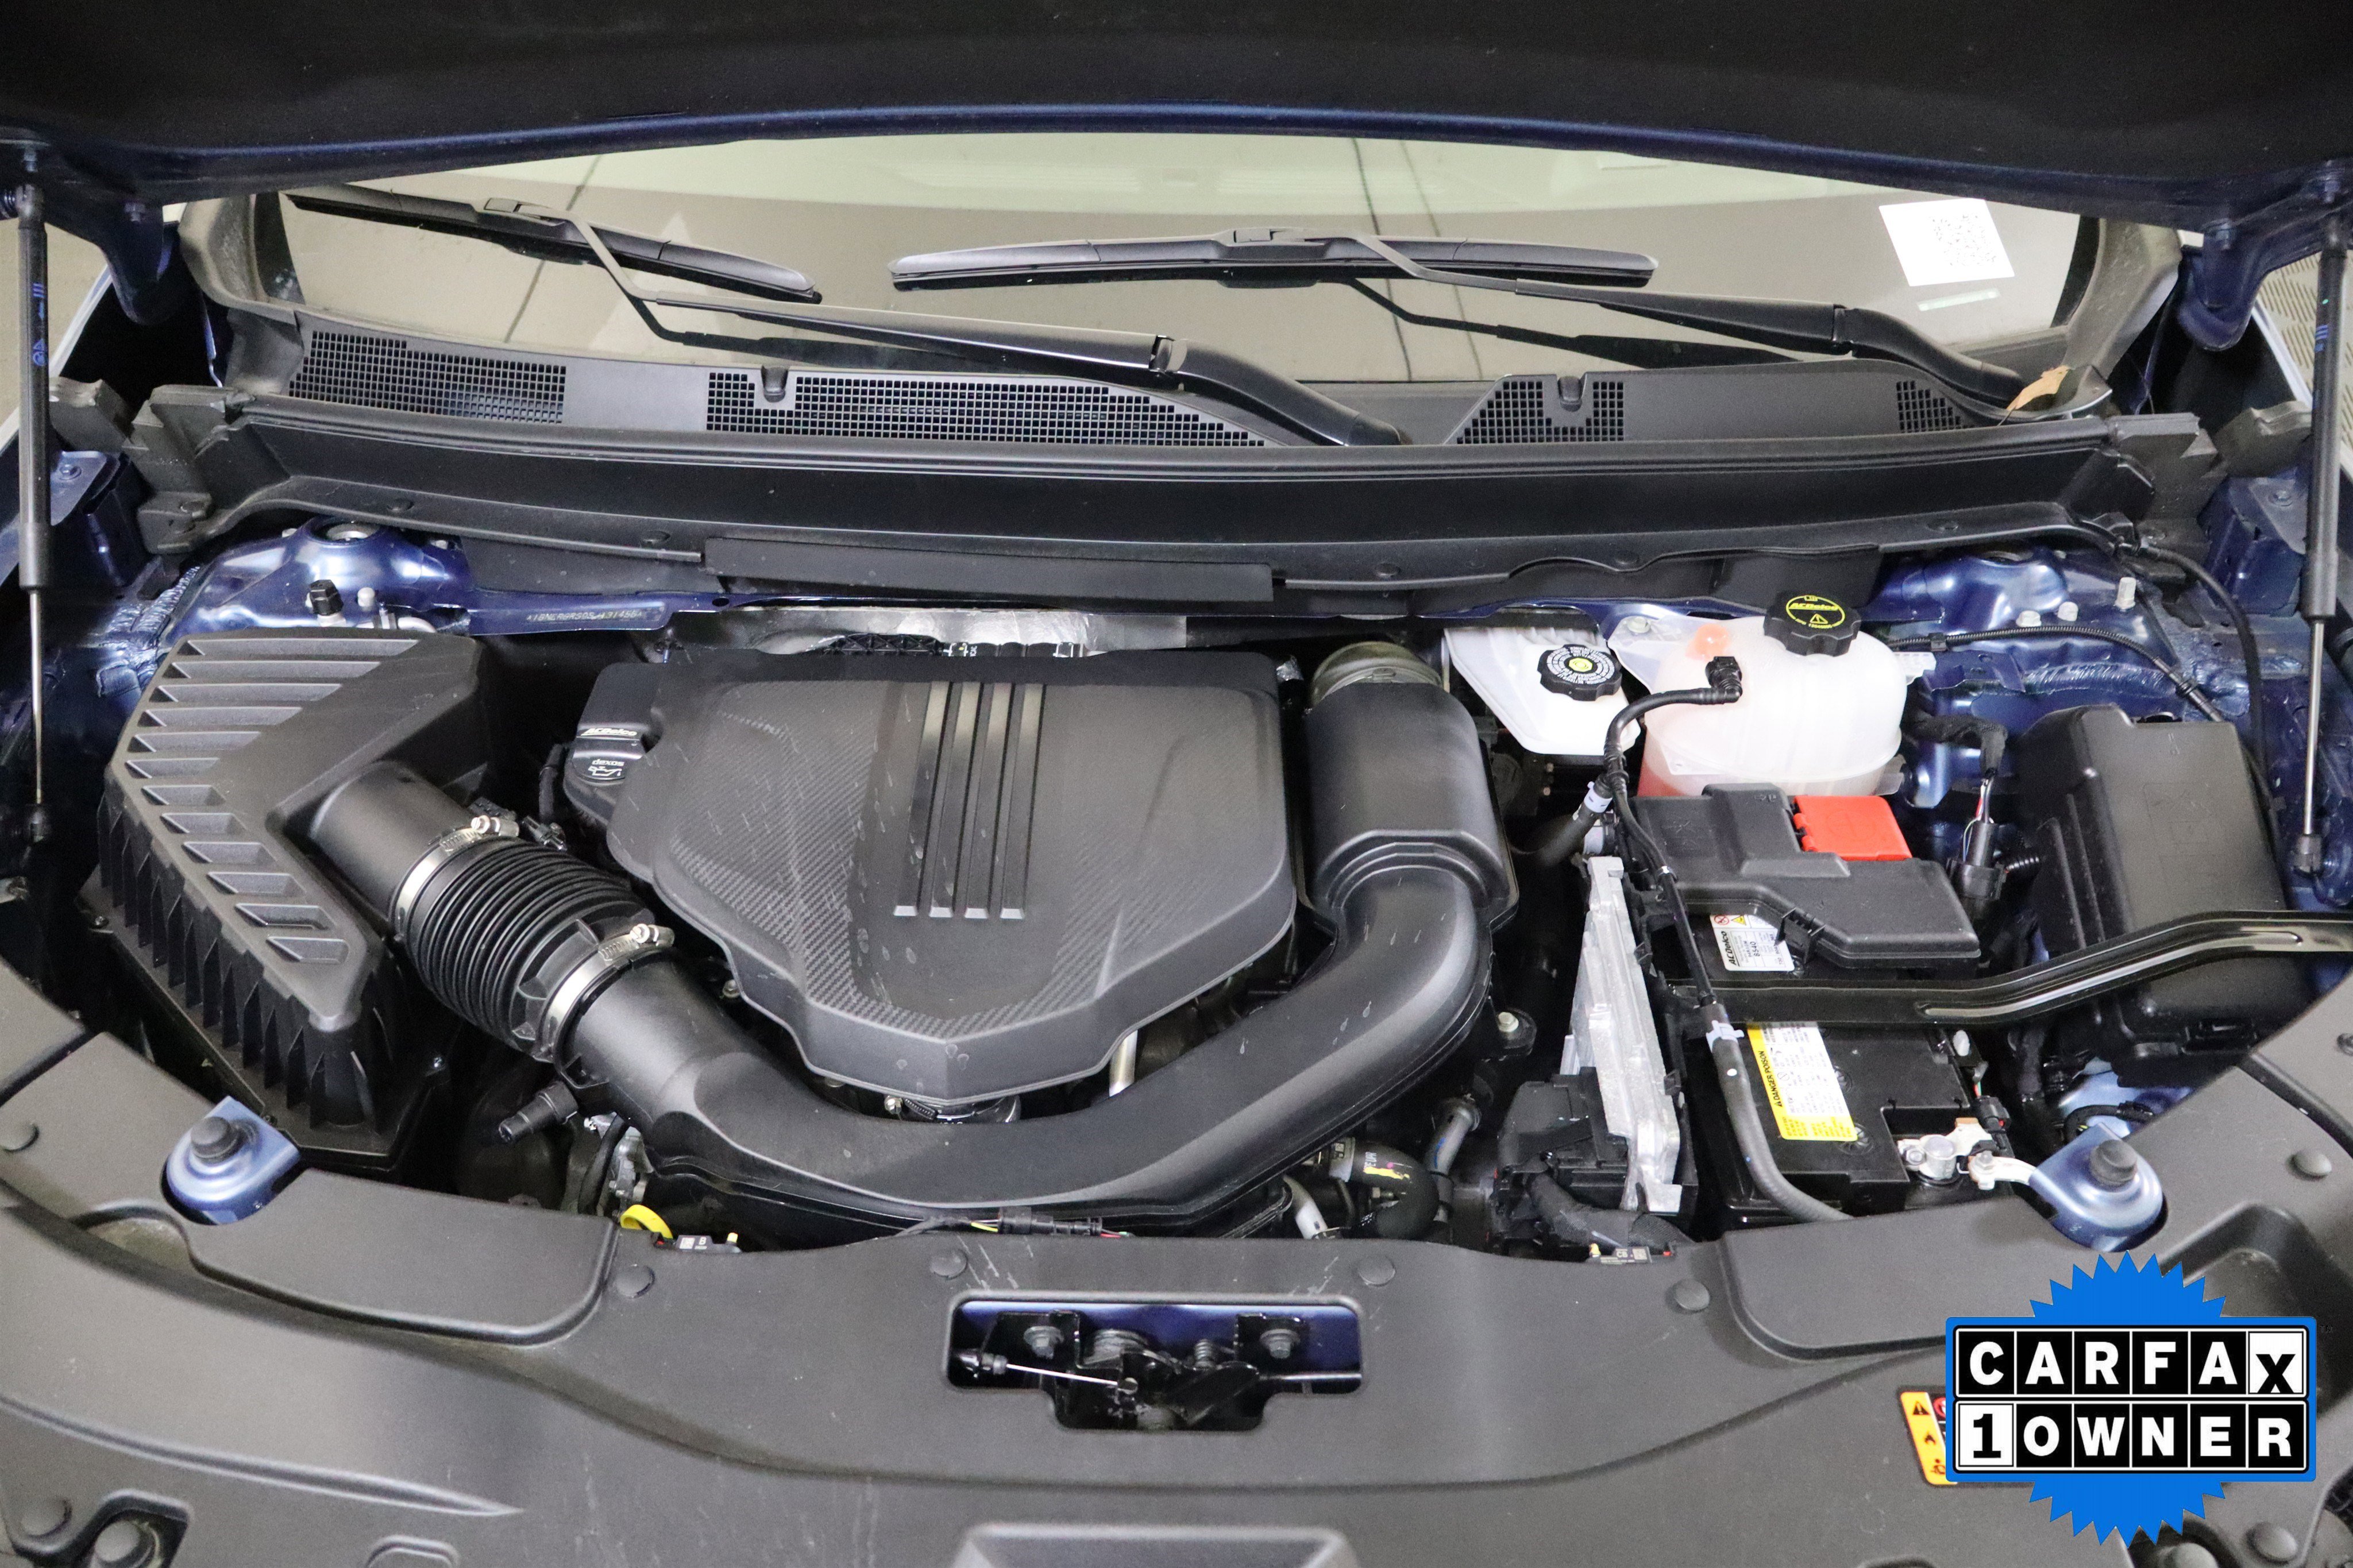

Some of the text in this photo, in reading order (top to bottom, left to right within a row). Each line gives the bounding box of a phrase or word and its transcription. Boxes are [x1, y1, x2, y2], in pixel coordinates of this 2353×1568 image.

[581, 728, 637, 736] ACDelco
[1721, 930, 1737, 965] ACDelco
[1758, 1051, 1780, 1100] DANGER POISON
